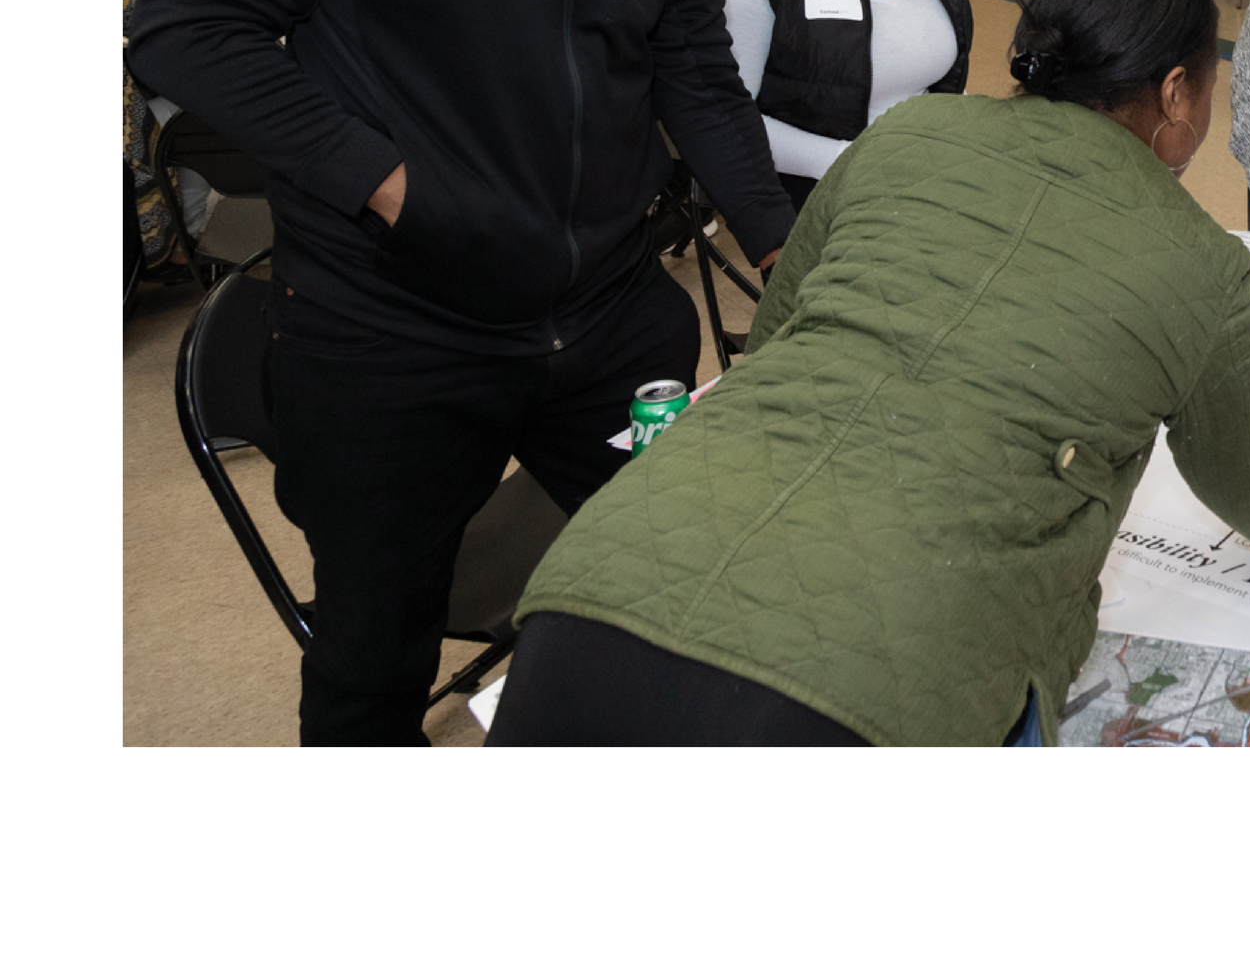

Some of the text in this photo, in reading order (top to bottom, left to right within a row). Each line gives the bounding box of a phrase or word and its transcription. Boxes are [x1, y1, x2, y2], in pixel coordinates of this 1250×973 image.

[630, 411, 676, 446] pri
[1117, 530, 1217, 568] asibility
[1117, 548, 1162, 569] difficult
[1164, 563, 1178, 574] to
[1179, 569, 1249, 599] implement
